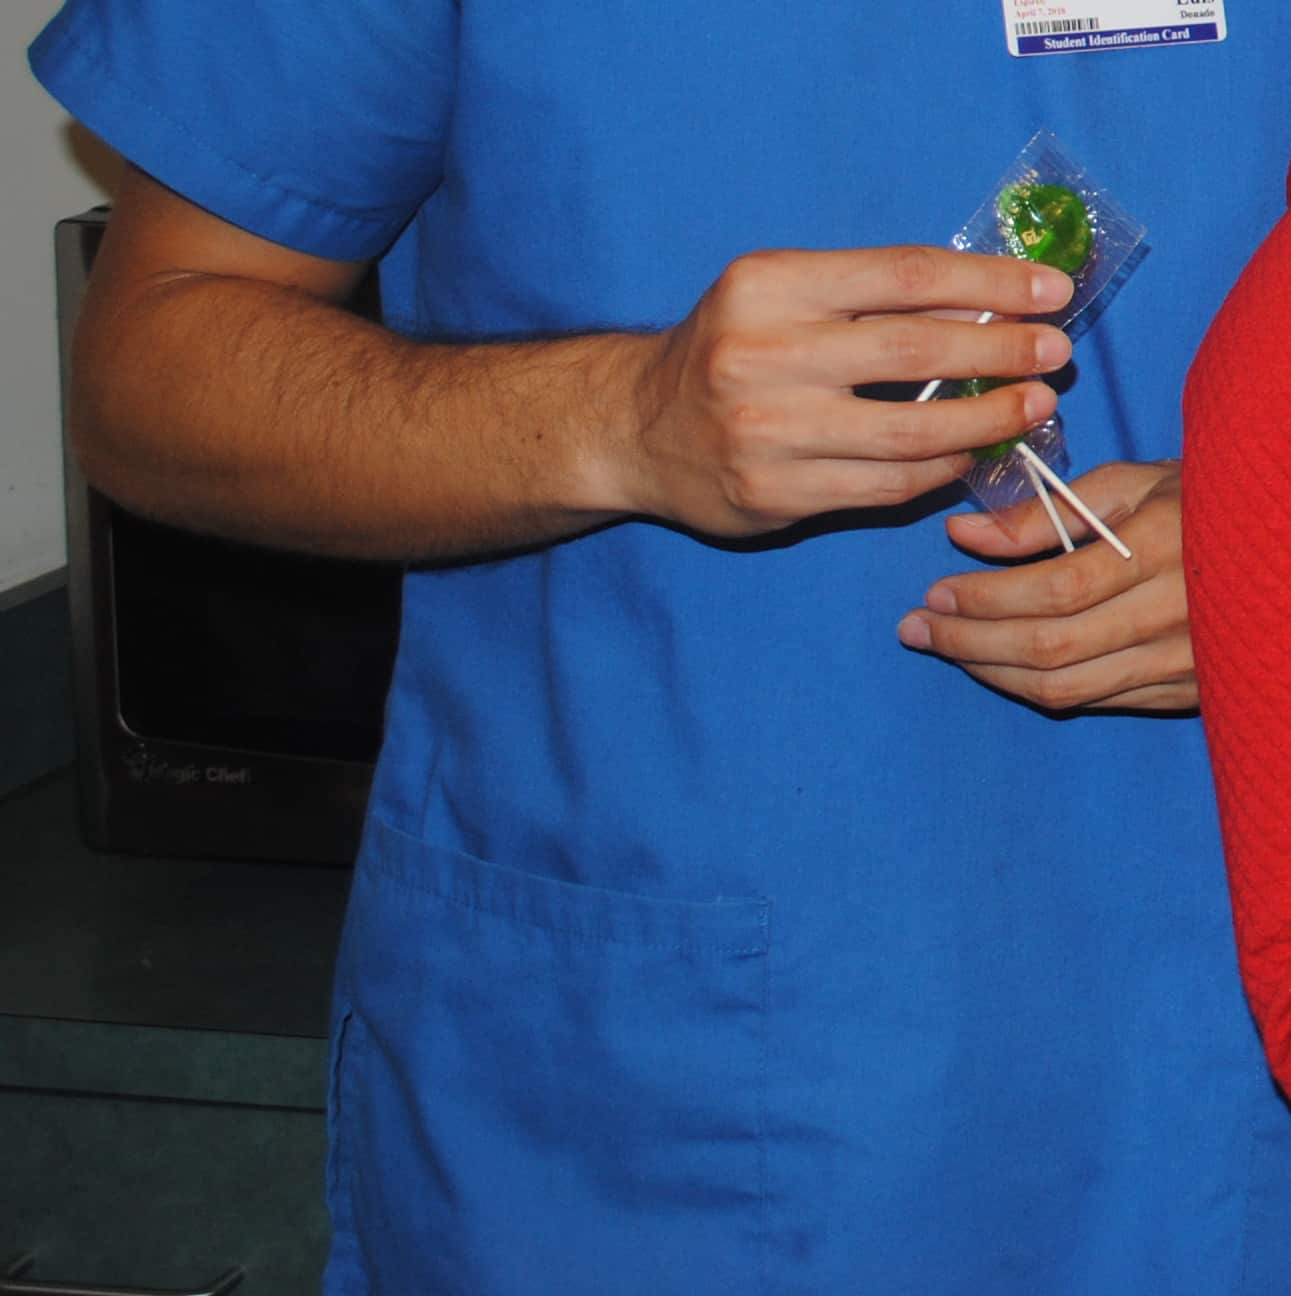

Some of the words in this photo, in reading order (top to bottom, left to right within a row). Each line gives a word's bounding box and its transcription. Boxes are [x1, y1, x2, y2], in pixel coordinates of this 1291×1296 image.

[1043, 34, 1087, 50] Student
[1088, 29, 1161, 48] Identification
[1161, 27, 1190, 42] Card
